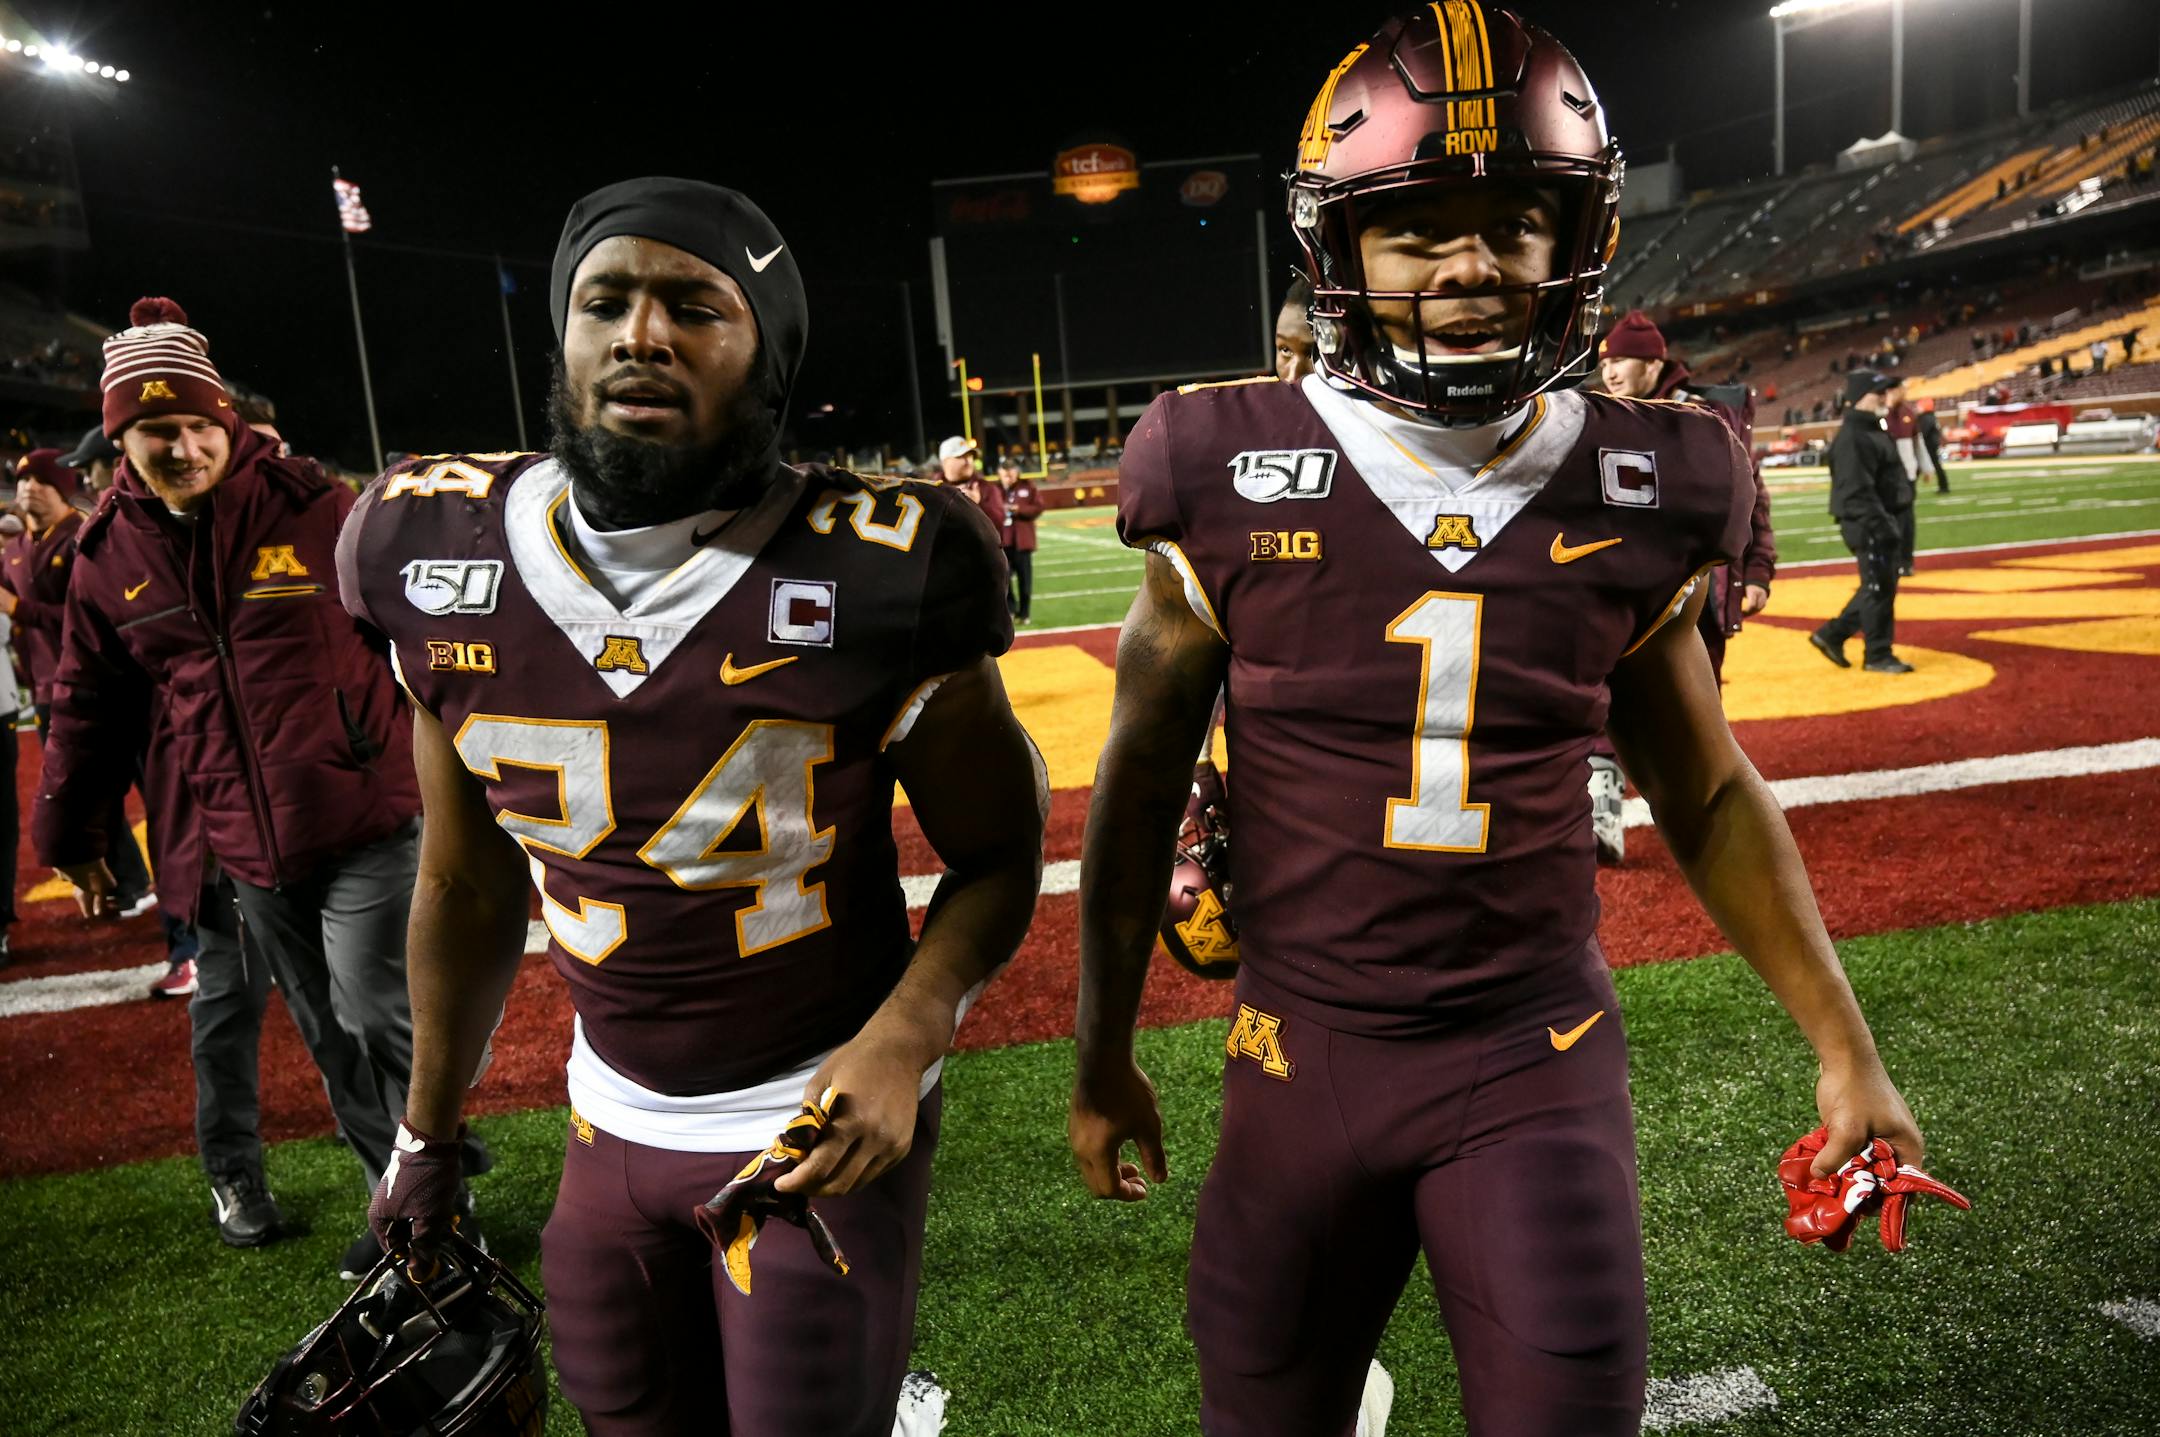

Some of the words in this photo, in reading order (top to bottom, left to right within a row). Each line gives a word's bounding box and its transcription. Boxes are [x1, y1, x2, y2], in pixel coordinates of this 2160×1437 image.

[1445, 129, 1498, 156] ROW
[139, 380, 176, 402] M
[1447, 384, 1494, 397] Riddell
[1227, 448, 1339, 504] 150
[1603, 451, 1656, 503] C
[1427, 515, 1479, 548] M
[251, 545, 309, 580] M
[399, 560, 504, 616] 150
[775, 582, 831, 641] C
[596, 636, 648, 674] M
[1384, 590, 1491, 853] 1
[453, 713, 836, 966] 24
[1227, 1004, 1288, 1077] M
